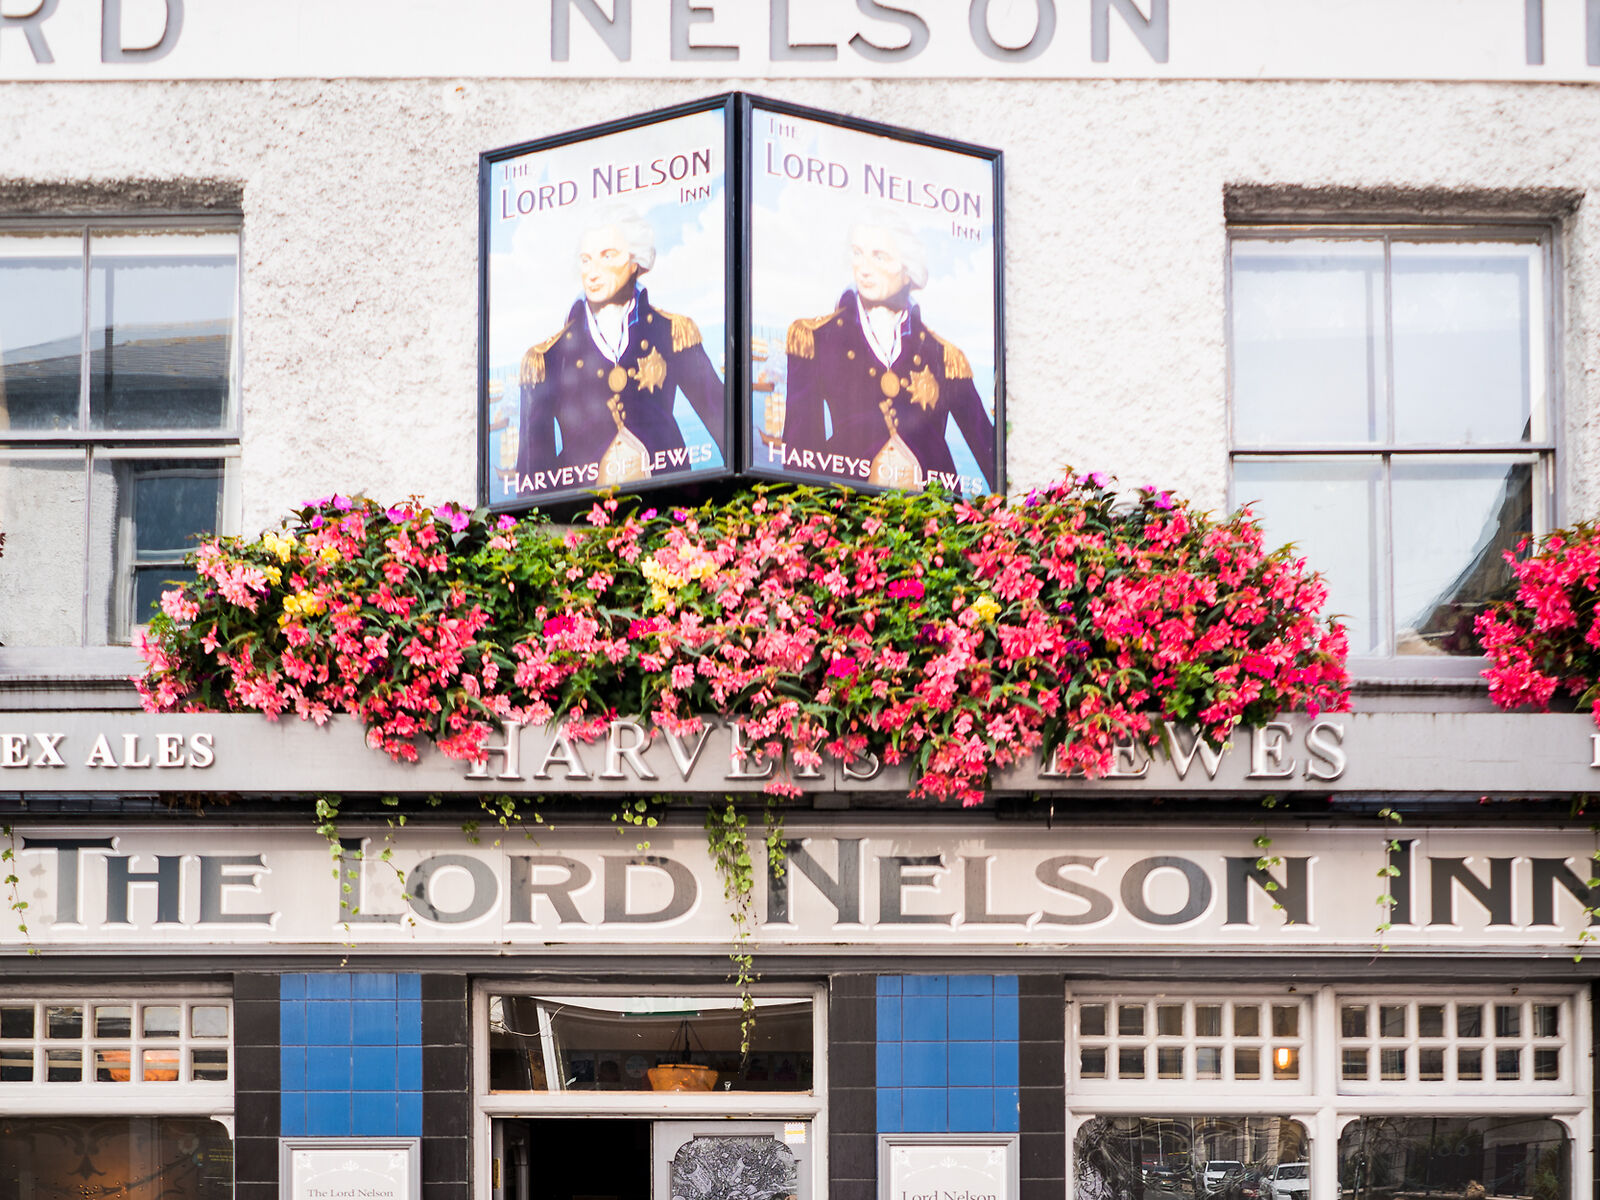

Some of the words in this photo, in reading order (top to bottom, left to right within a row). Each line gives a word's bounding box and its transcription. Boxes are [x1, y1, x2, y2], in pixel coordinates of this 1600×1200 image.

[551, 0, 1169, 63] NELSON
[769, 118, 795, 138] THE
[502, 180, 578, 219] LORD
[593, 149, 711, 199] NELSON
[504, 163, 528, 180] THE
[767, 142, 848, 188] LORD
[864, 163, 981, 218] NELSON
[680, 185, 710, 203] INN
[952, 221, 981, 241] INN
[503, 462, 599, 496] HARVEYS
[606, 459, 632, 476] OF
[641, 443, 712, 473] LEWES
[768, 441, 871, 478] HARVEYS
[878, 463, 904, 481] OF
[913, 465, 983, 495] LEWES
[0, 733, 66, 767] EX
[85, 733, 214, 768] ALES
[22, 836, 278, 931] THE
[333, 837, 700, 931] LORD
[763, 837, 1318, 931] NELSON
[1387, 838, 1600, 932] INN
[307, 1189, 328, 1197] The
[330, 1189, 355, 1197] Lord
[358, 1189, 393, 1197] Nelson
